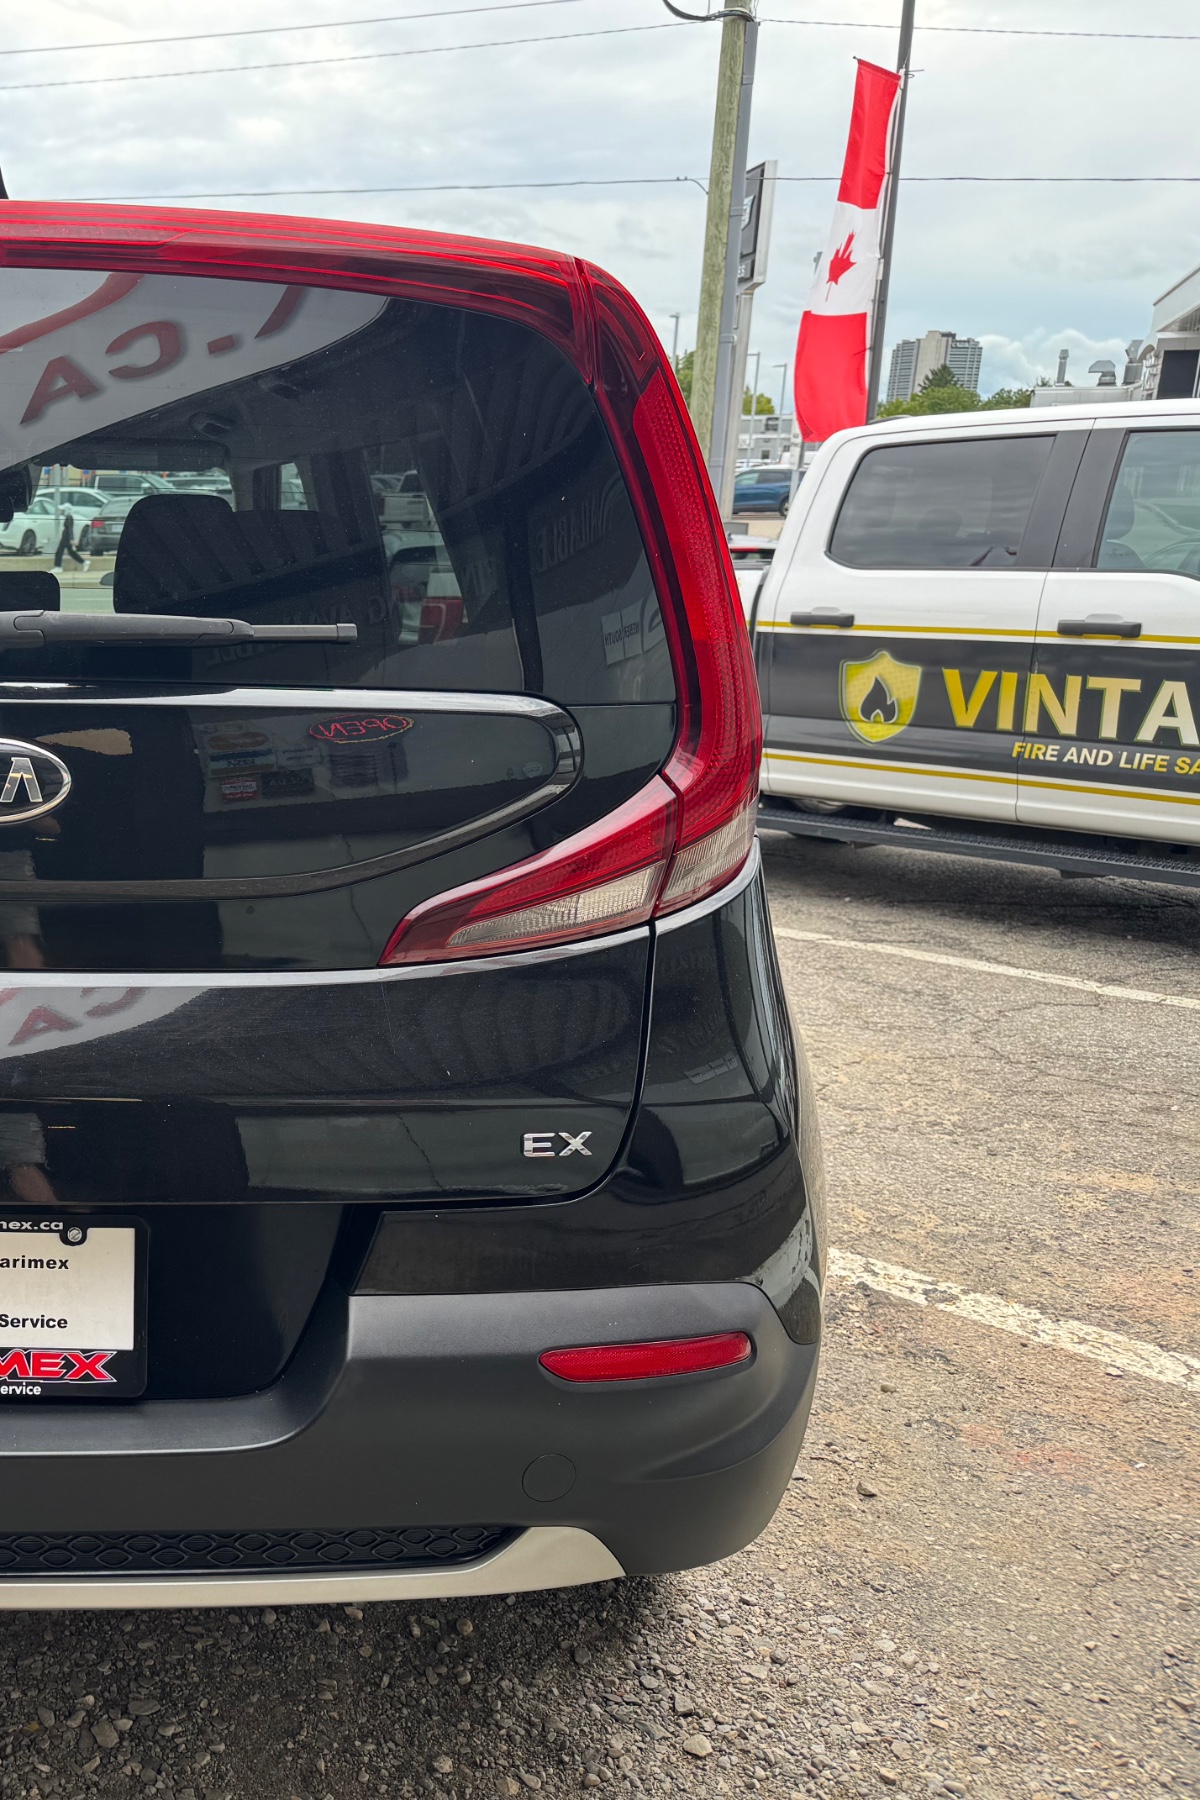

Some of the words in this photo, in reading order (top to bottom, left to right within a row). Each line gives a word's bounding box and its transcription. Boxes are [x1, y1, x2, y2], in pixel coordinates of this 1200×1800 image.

[942, 667, 1200, 747] VINTA
[1011, 741, 1060, 761] FIRE
[1063, 746, 1113, 766] AND
[1119, 752, 1170, 773] LIFE
[523, 1131, 593, 1158] EX
